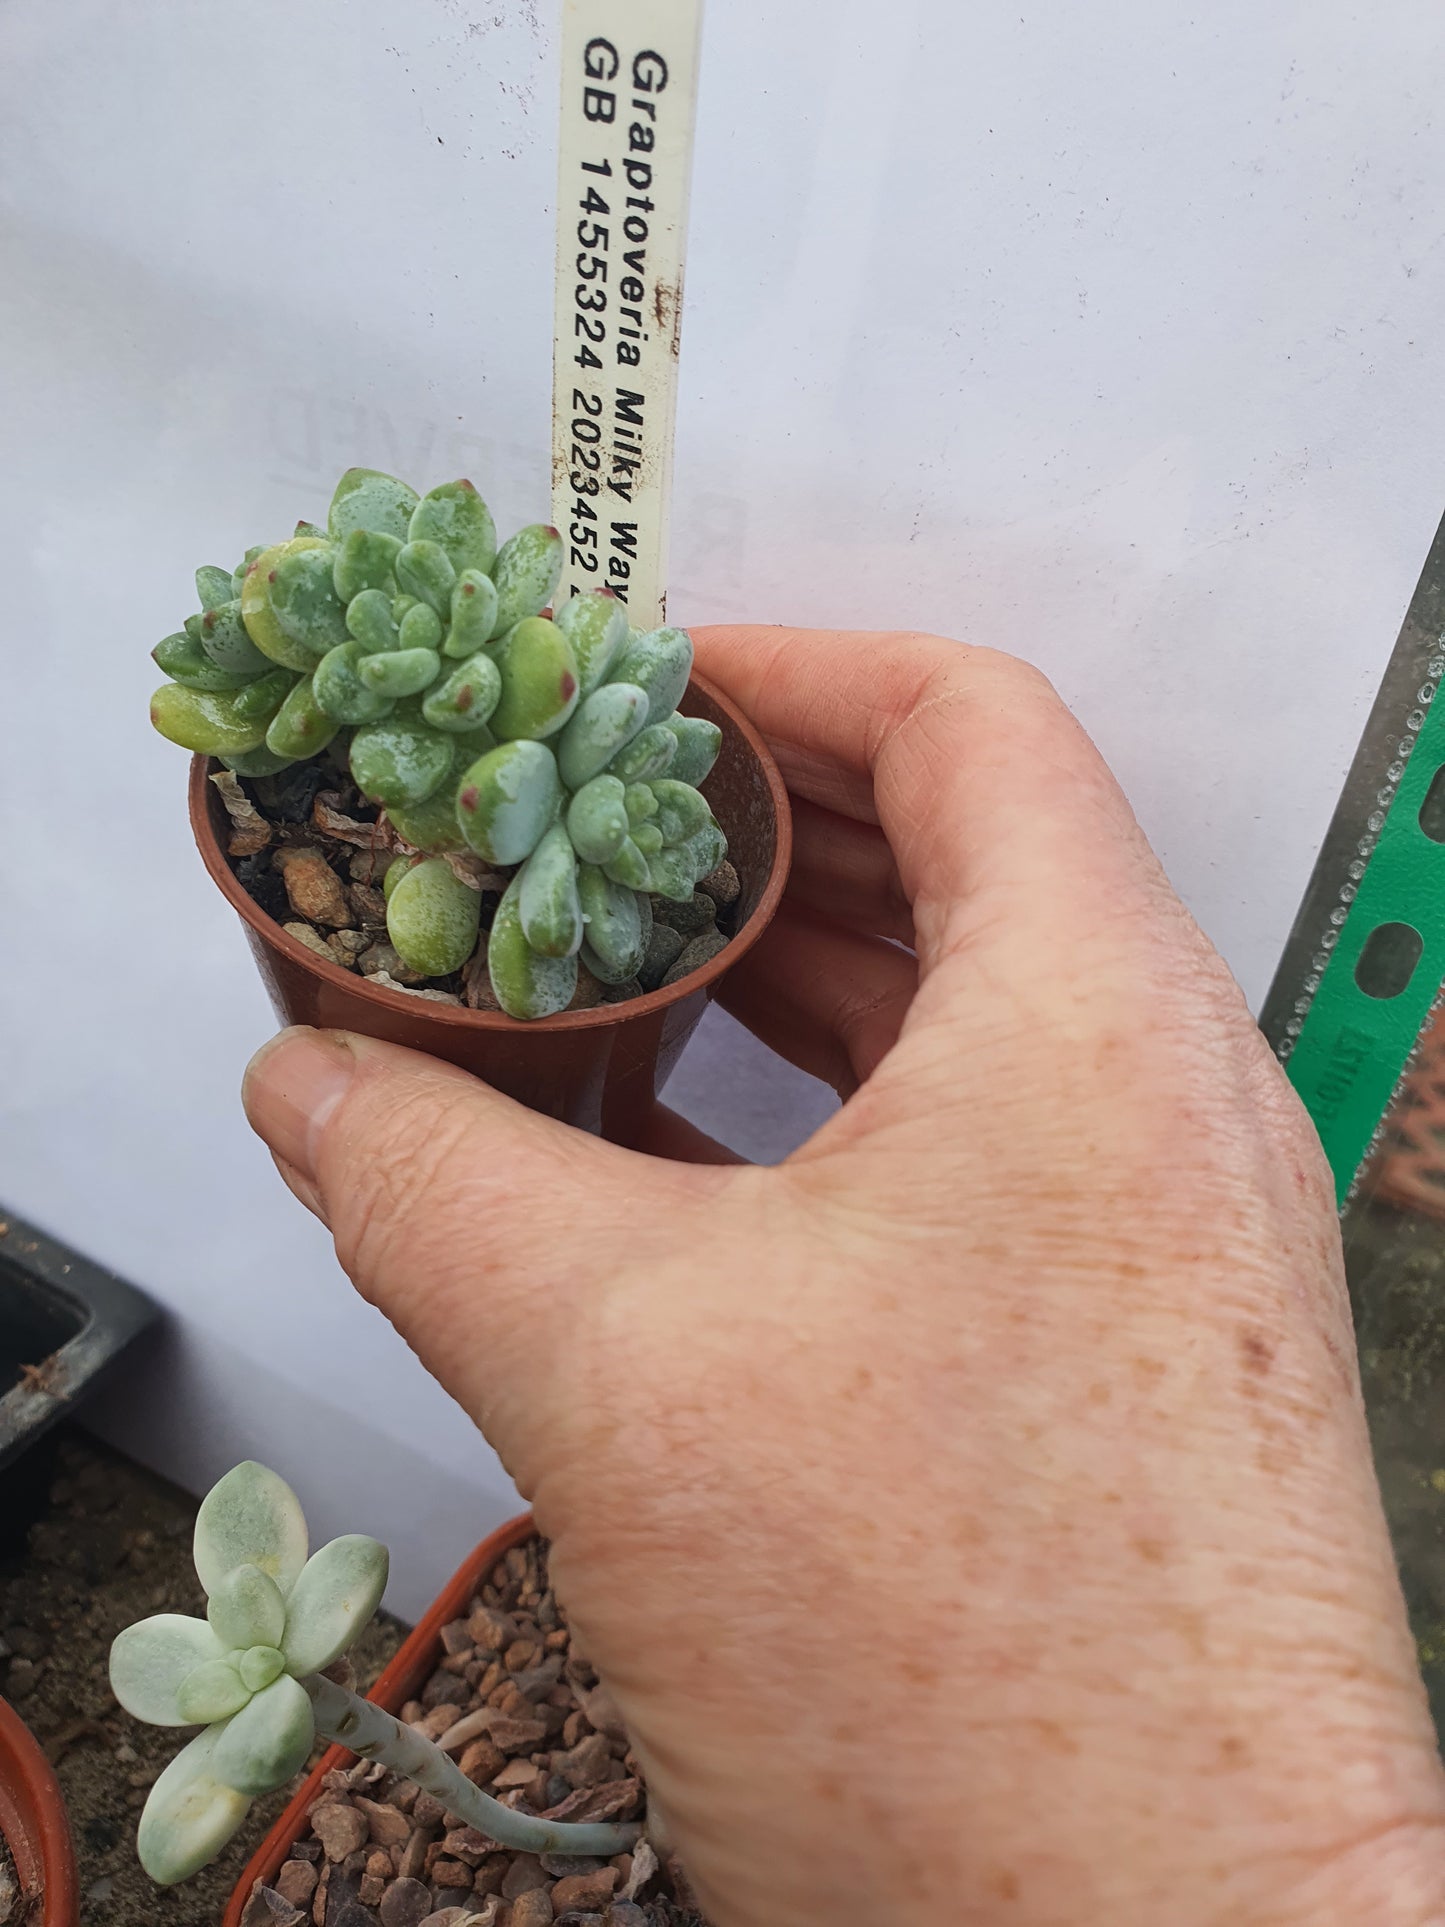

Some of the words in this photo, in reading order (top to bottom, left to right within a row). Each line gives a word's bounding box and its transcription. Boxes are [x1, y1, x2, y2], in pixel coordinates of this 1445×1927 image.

[581, 37, 620, 124] GB
[574, 158, 613, 370] 1455324
[616, 49, 669, 368] Graptoveria
[569, 388, 603, 573] 2023452
[606, 387, 645, 504] Milky
[604, 521, 638, 605] Way
